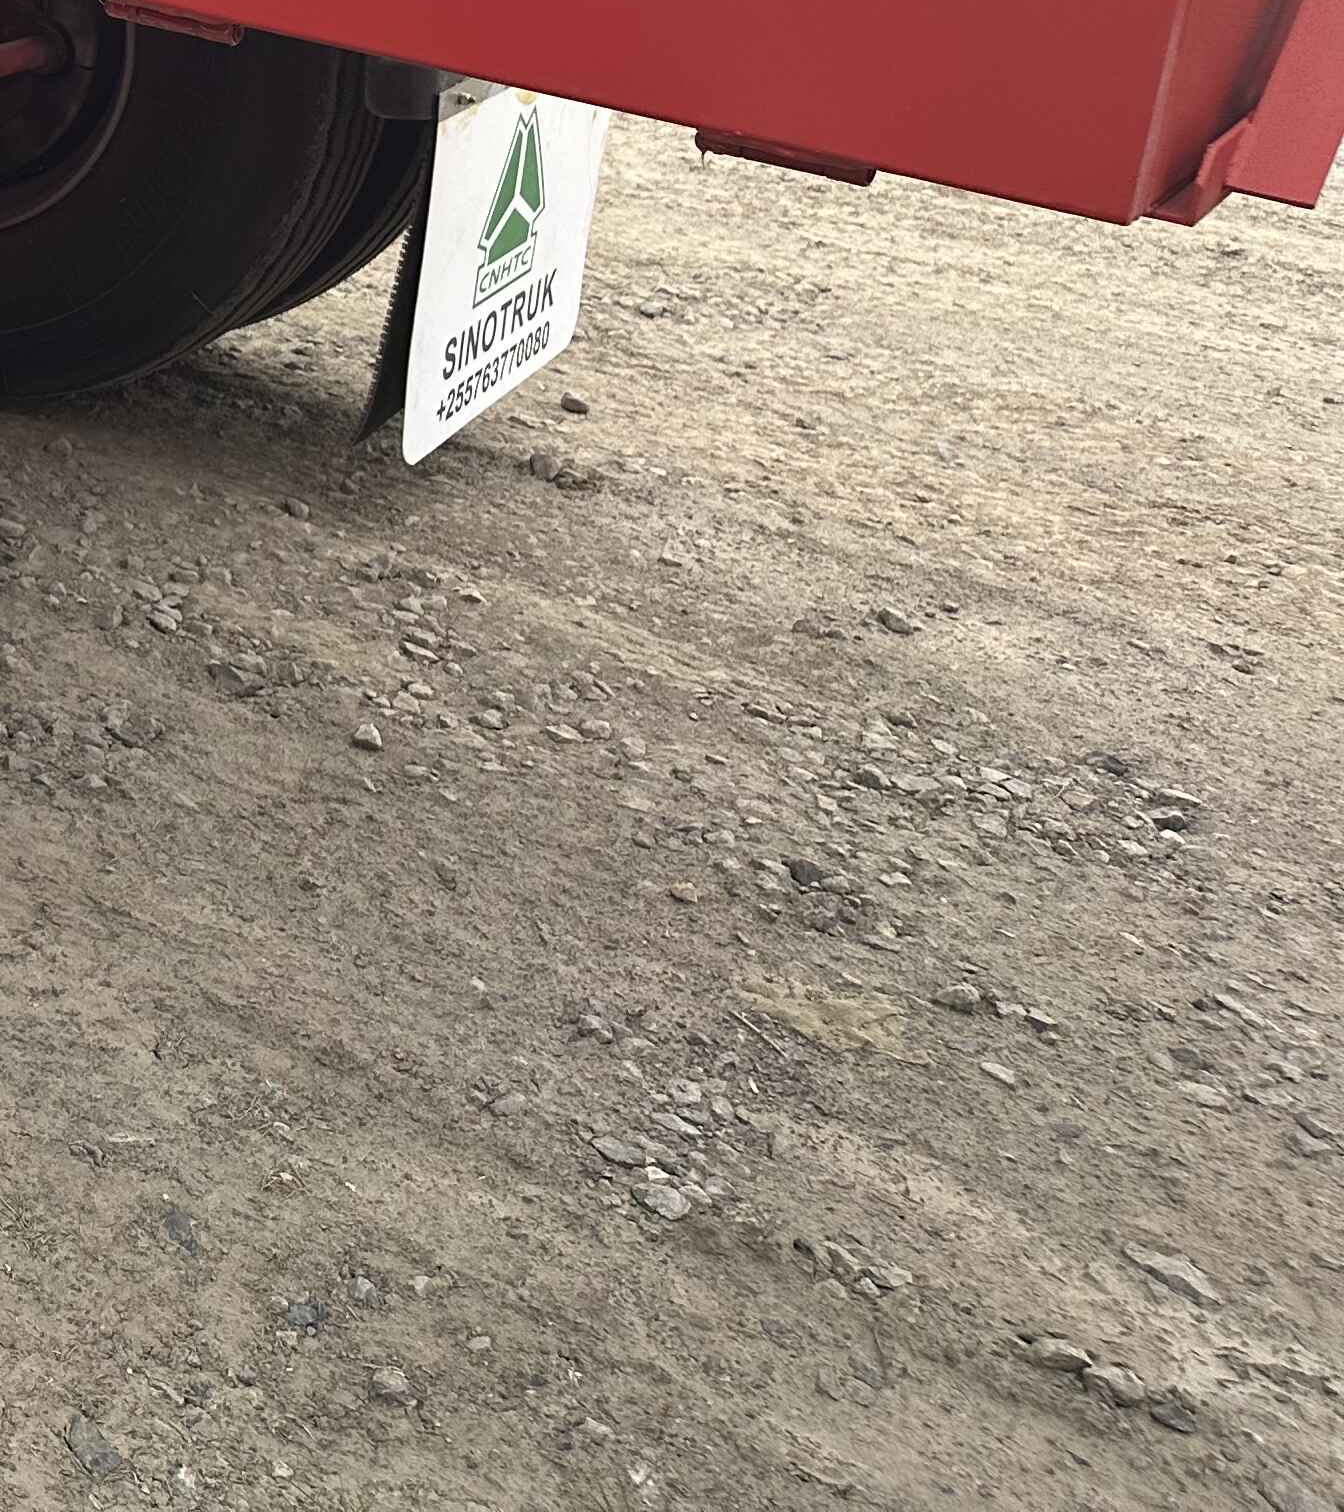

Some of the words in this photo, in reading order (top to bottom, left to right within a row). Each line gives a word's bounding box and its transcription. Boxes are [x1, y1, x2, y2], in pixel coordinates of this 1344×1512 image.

[478, 245, 533, 293] CNHTC
[436, 321, 551, 421] +255763770080
[442, 268, 557, 380] SINOTRUK
